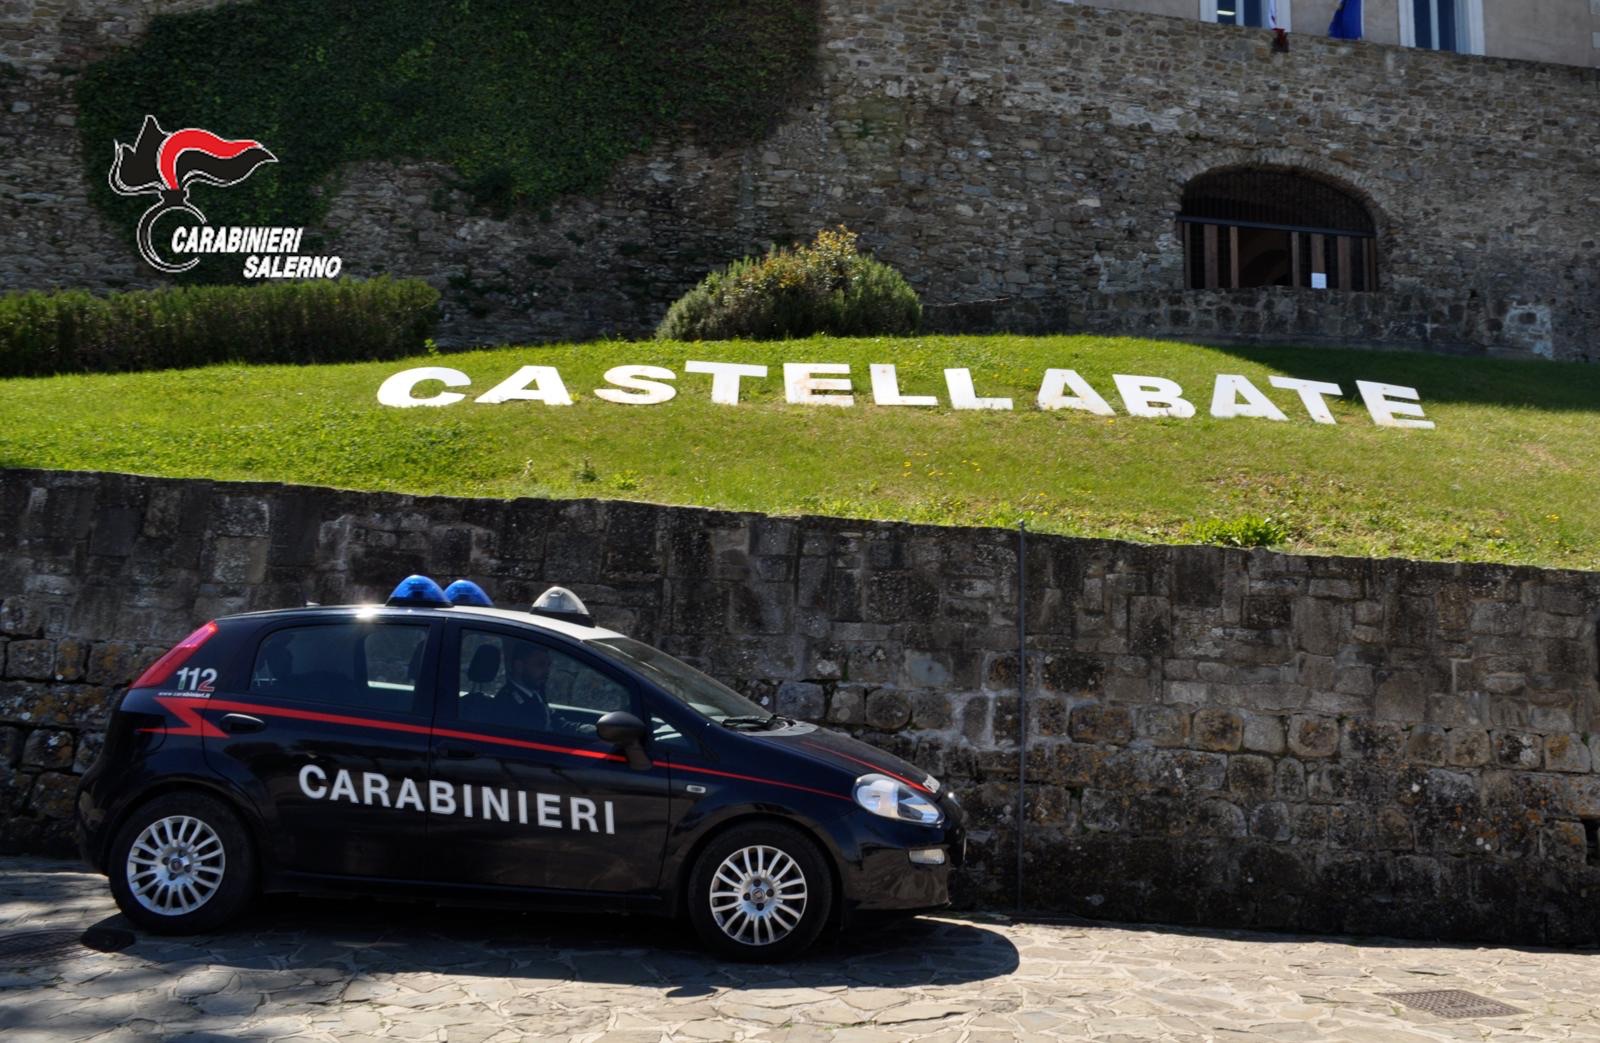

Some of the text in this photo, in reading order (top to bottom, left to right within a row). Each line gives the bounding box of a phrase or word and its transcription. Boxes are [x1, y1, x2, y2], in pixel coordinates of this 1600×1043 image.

[377, 361, 1436, 429] CASTELLABATE
[177, 667, 218, 692] 112
[298, 764, 616, 834] CARABINIERI
